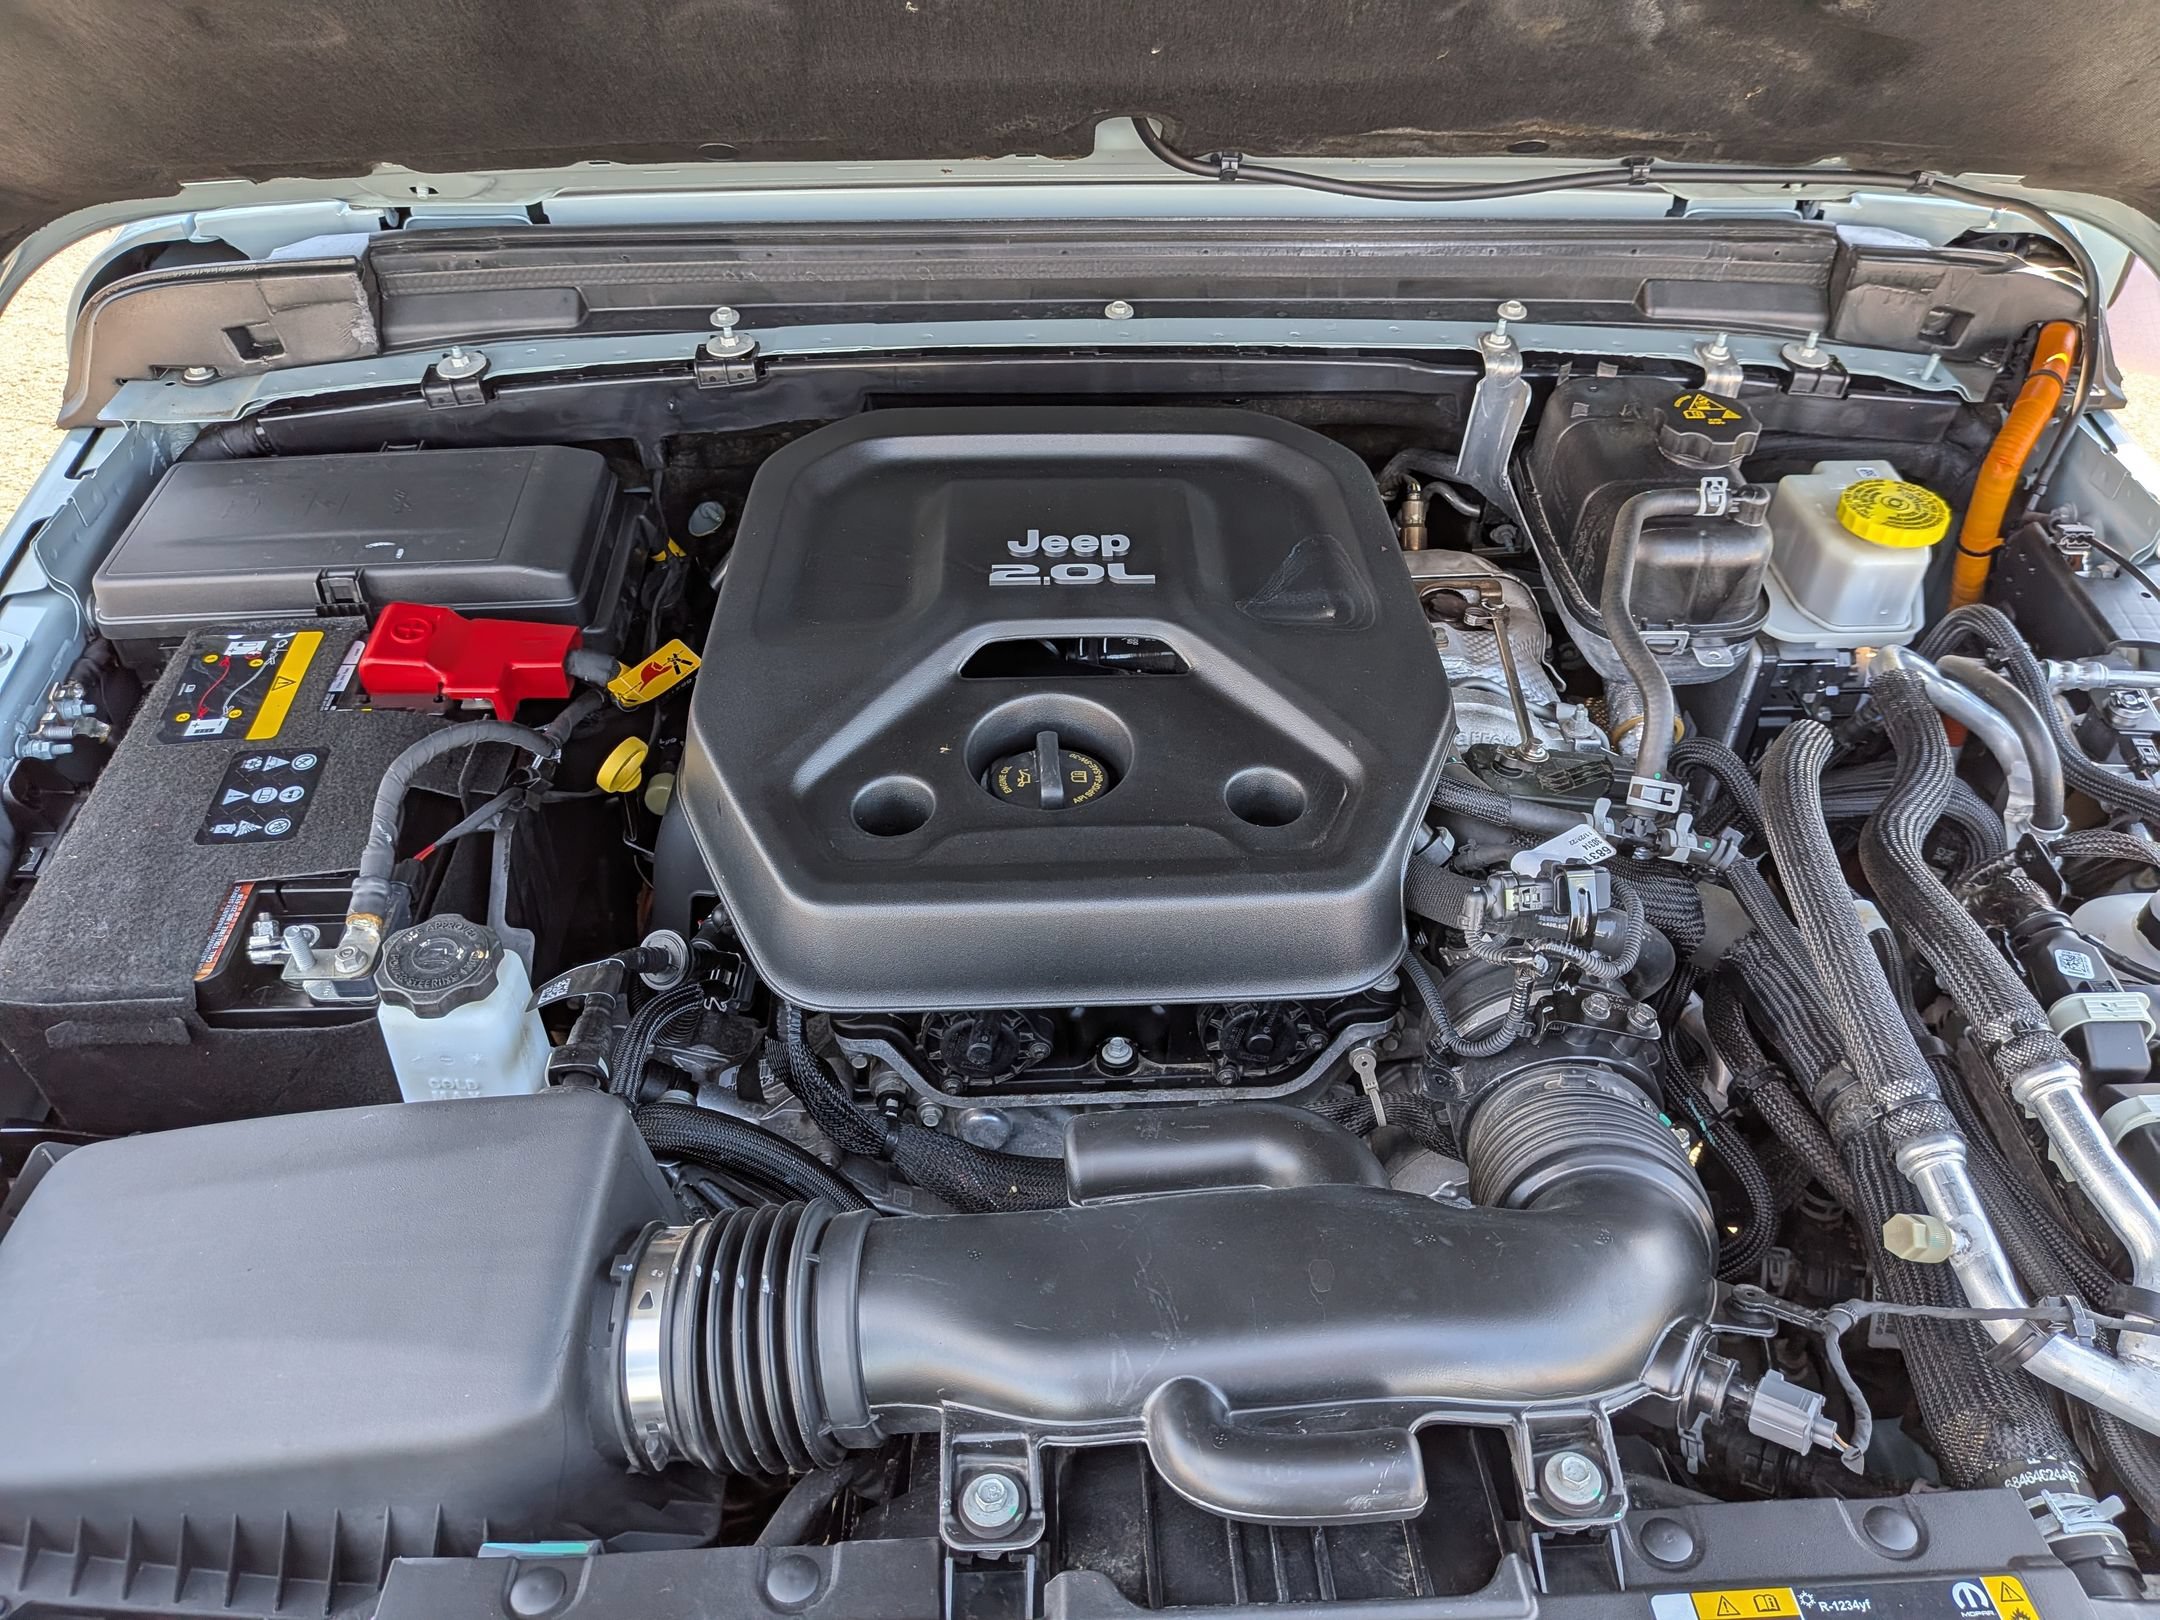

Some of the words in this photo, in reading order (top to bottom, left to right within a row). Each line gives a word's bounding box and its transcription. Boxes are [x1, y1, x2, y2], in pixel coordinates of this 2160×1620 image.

[1007, 529, 1131, 561] Jeep
[989, 563, 1156, 586] 2.0L
[1000, 765, 1014, 775] OIL
[998, 774, 1013, 795] ENGINE
[1073, 794, 1088, 804] API
[1583, 846, 1612, 862] 6831
[403, 929, 423, 942] USE
[425, 920, 478, 942] APPROVED
[428, 1077, 479, 1091] COLD
[1818, 1598, 1872, 1612] R-1234yf
[1960, 1610, 1996, 1618] MOPAR
